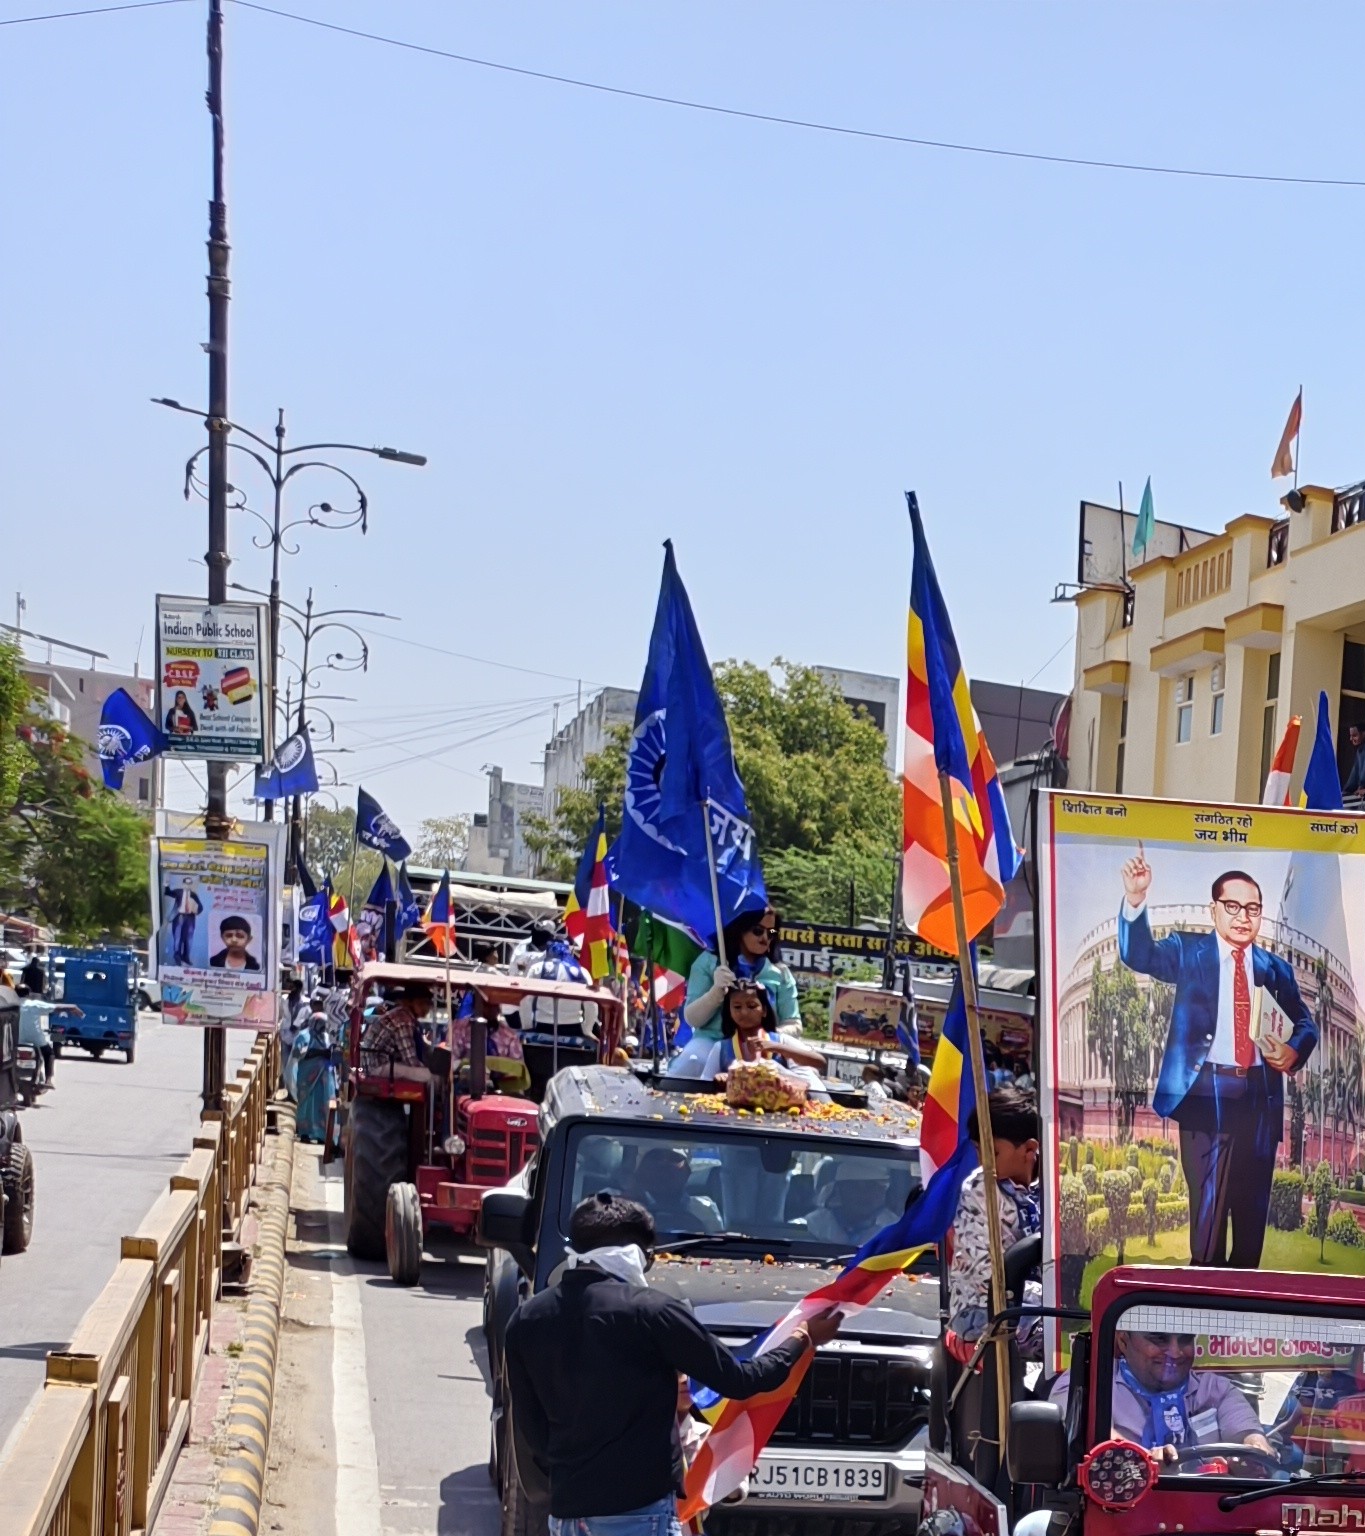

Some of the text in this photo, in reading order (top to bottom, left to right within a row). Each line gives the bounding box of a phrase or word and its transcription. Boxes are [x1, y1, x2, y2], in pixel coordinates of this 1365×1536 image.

[163, 621, 255, 639] Indian Public School
[1106, 803, 1127, 818] बनो
[1194, 811, 1253, 829] संगठित रहो
[1194, 827, 1249, 844] जय भीम
[1340, 822, 1359, 836] करो
[749, 1465, 883, 1488] RJ51CB1839
